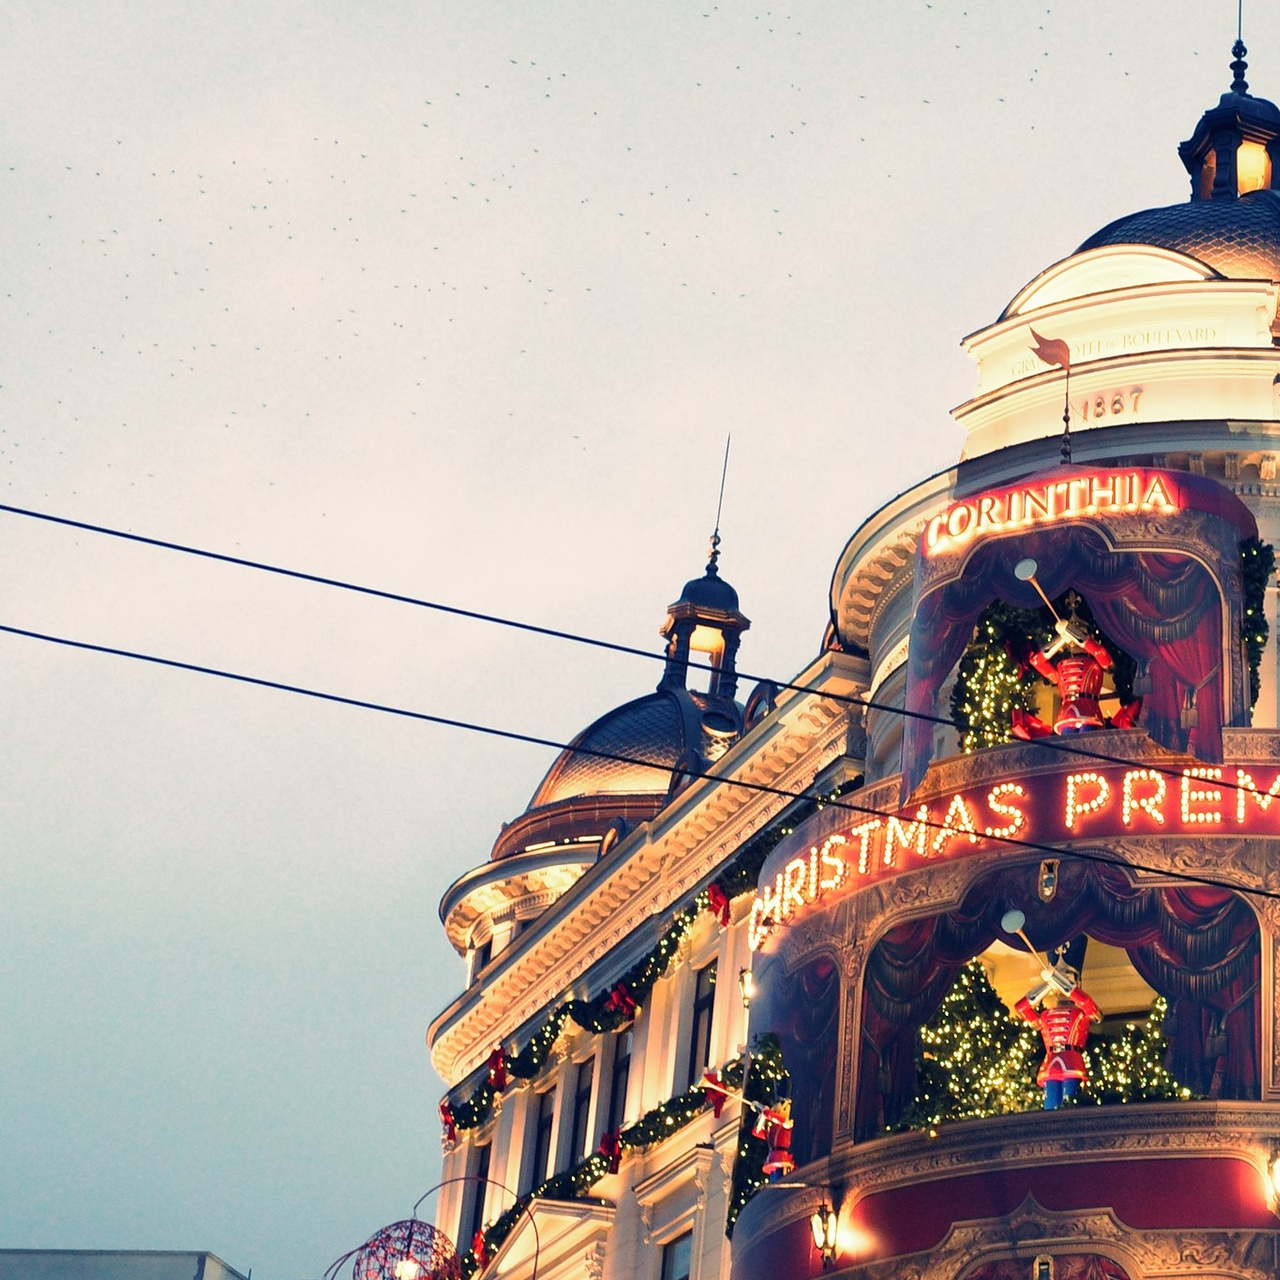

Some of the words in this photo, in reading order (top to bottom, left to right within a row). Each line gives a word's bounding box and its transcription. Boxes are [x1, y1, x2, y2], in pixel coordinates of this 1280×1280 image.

[1072, 339, 1101, 356] OTEL
[1123, 327, 1216, 349] BOULEVARD
[1081, 387, 1144, 422] 1867
[926, 472, 1173, 548] CORINTHIA
[748, 783, 1025, 952] CHRISTMAS
